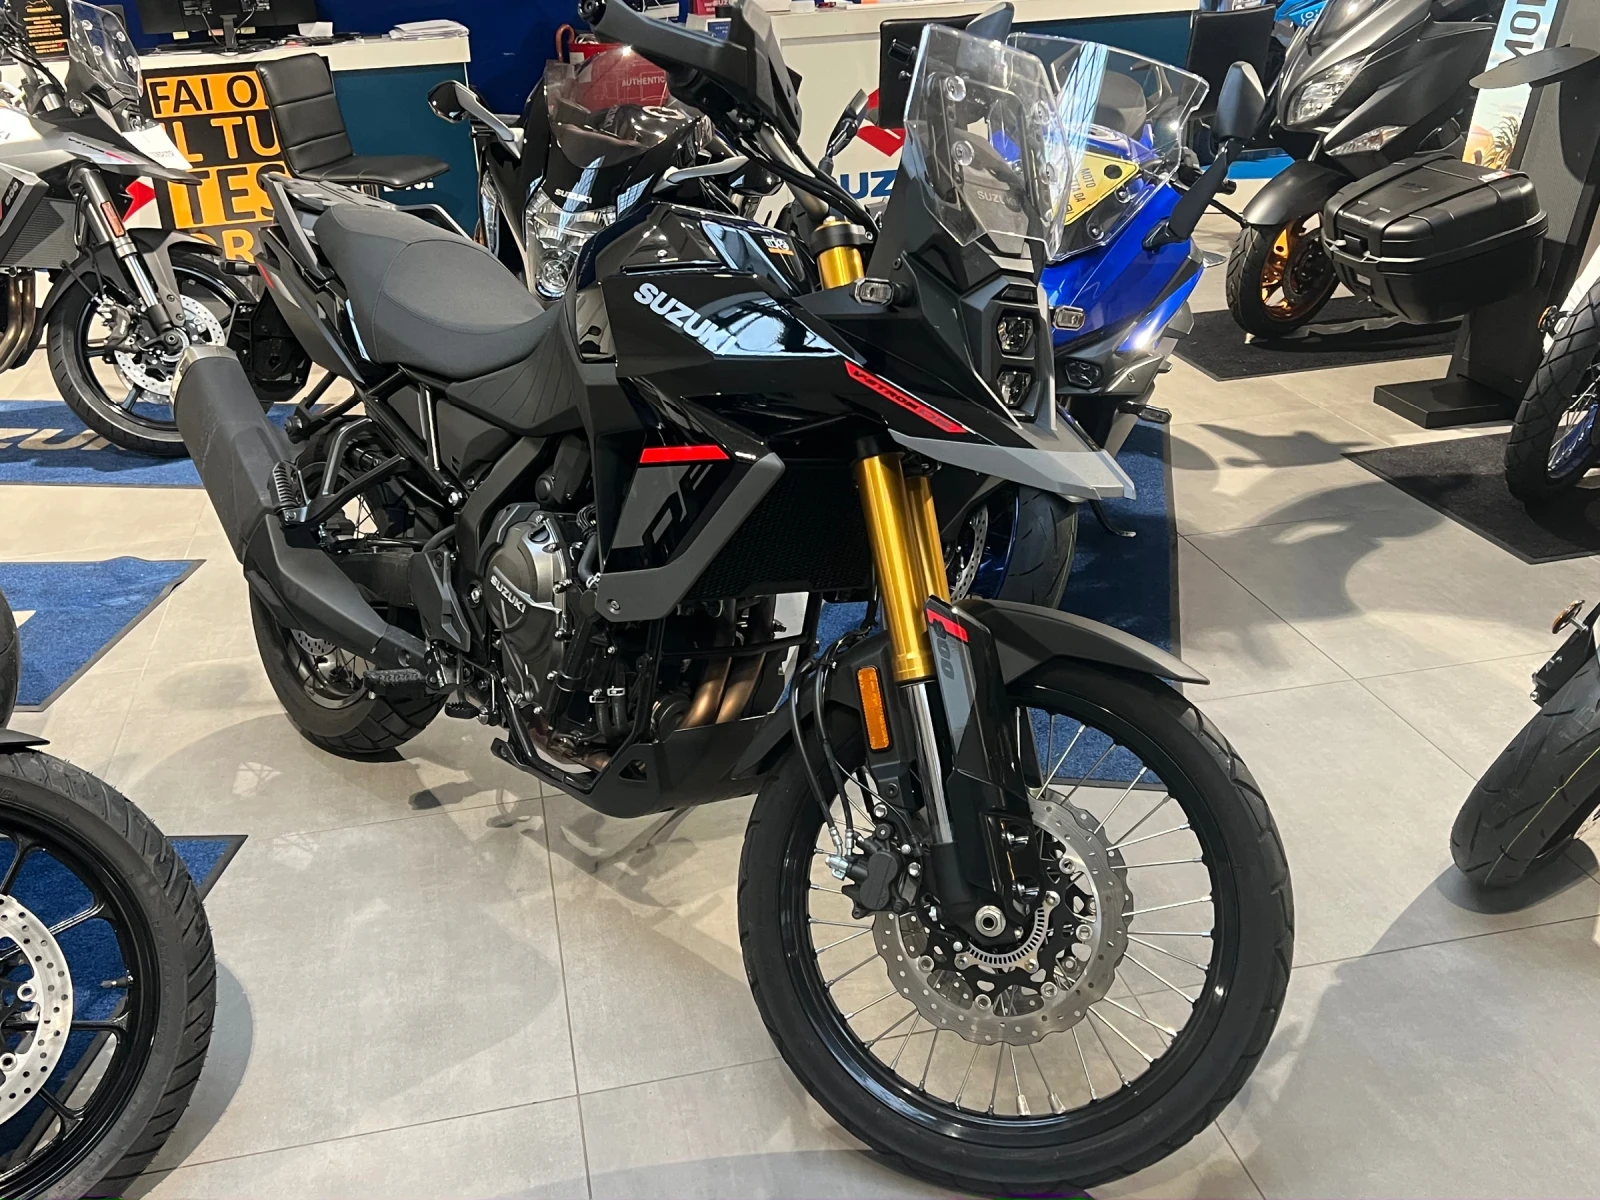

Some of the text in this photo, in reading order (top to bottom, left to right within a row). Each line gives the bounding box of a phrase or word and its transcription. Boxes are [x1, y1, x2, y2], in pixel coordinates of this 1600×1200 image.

[149, 78, 213, 114] FAI
[621, 76, 666, 88] AUTHENTIC
[554, 188, 593, 204] SUZUKI
[1081, 168, 1096, 188] MOTO
[633, 282, 738, 355] SUZUKI
[853, 369, 919, 410] V-STROM
[490, 575, 527, 614] SUZUKI
